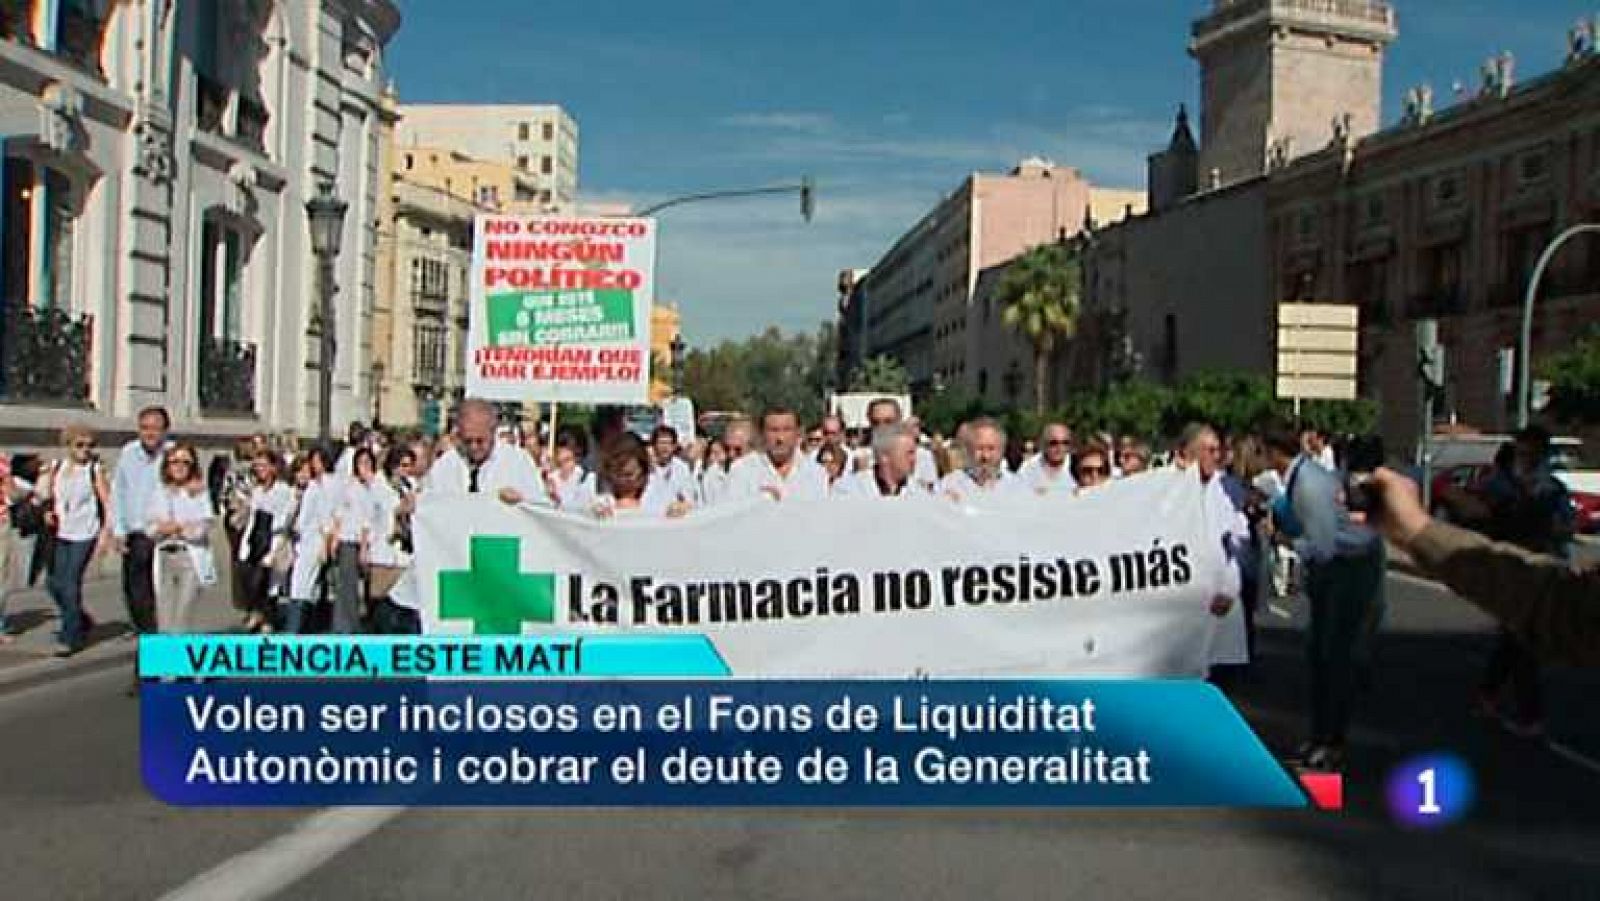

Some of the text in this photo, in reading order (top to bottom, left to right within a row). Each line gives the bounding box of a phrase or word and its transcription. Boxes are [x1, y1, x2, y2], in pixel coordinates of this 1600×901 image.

[484, 220, 646, 236] NO CONOZCO
[486, 238, 625, 262] NINGÚN
[485, 263, 642, 288] POLÍTICO
[598, 349, 642, 363] QUE
[480, 365, 526, 379] DAR
[568, 538, 1192, 625] La Farmacia no resiste más
